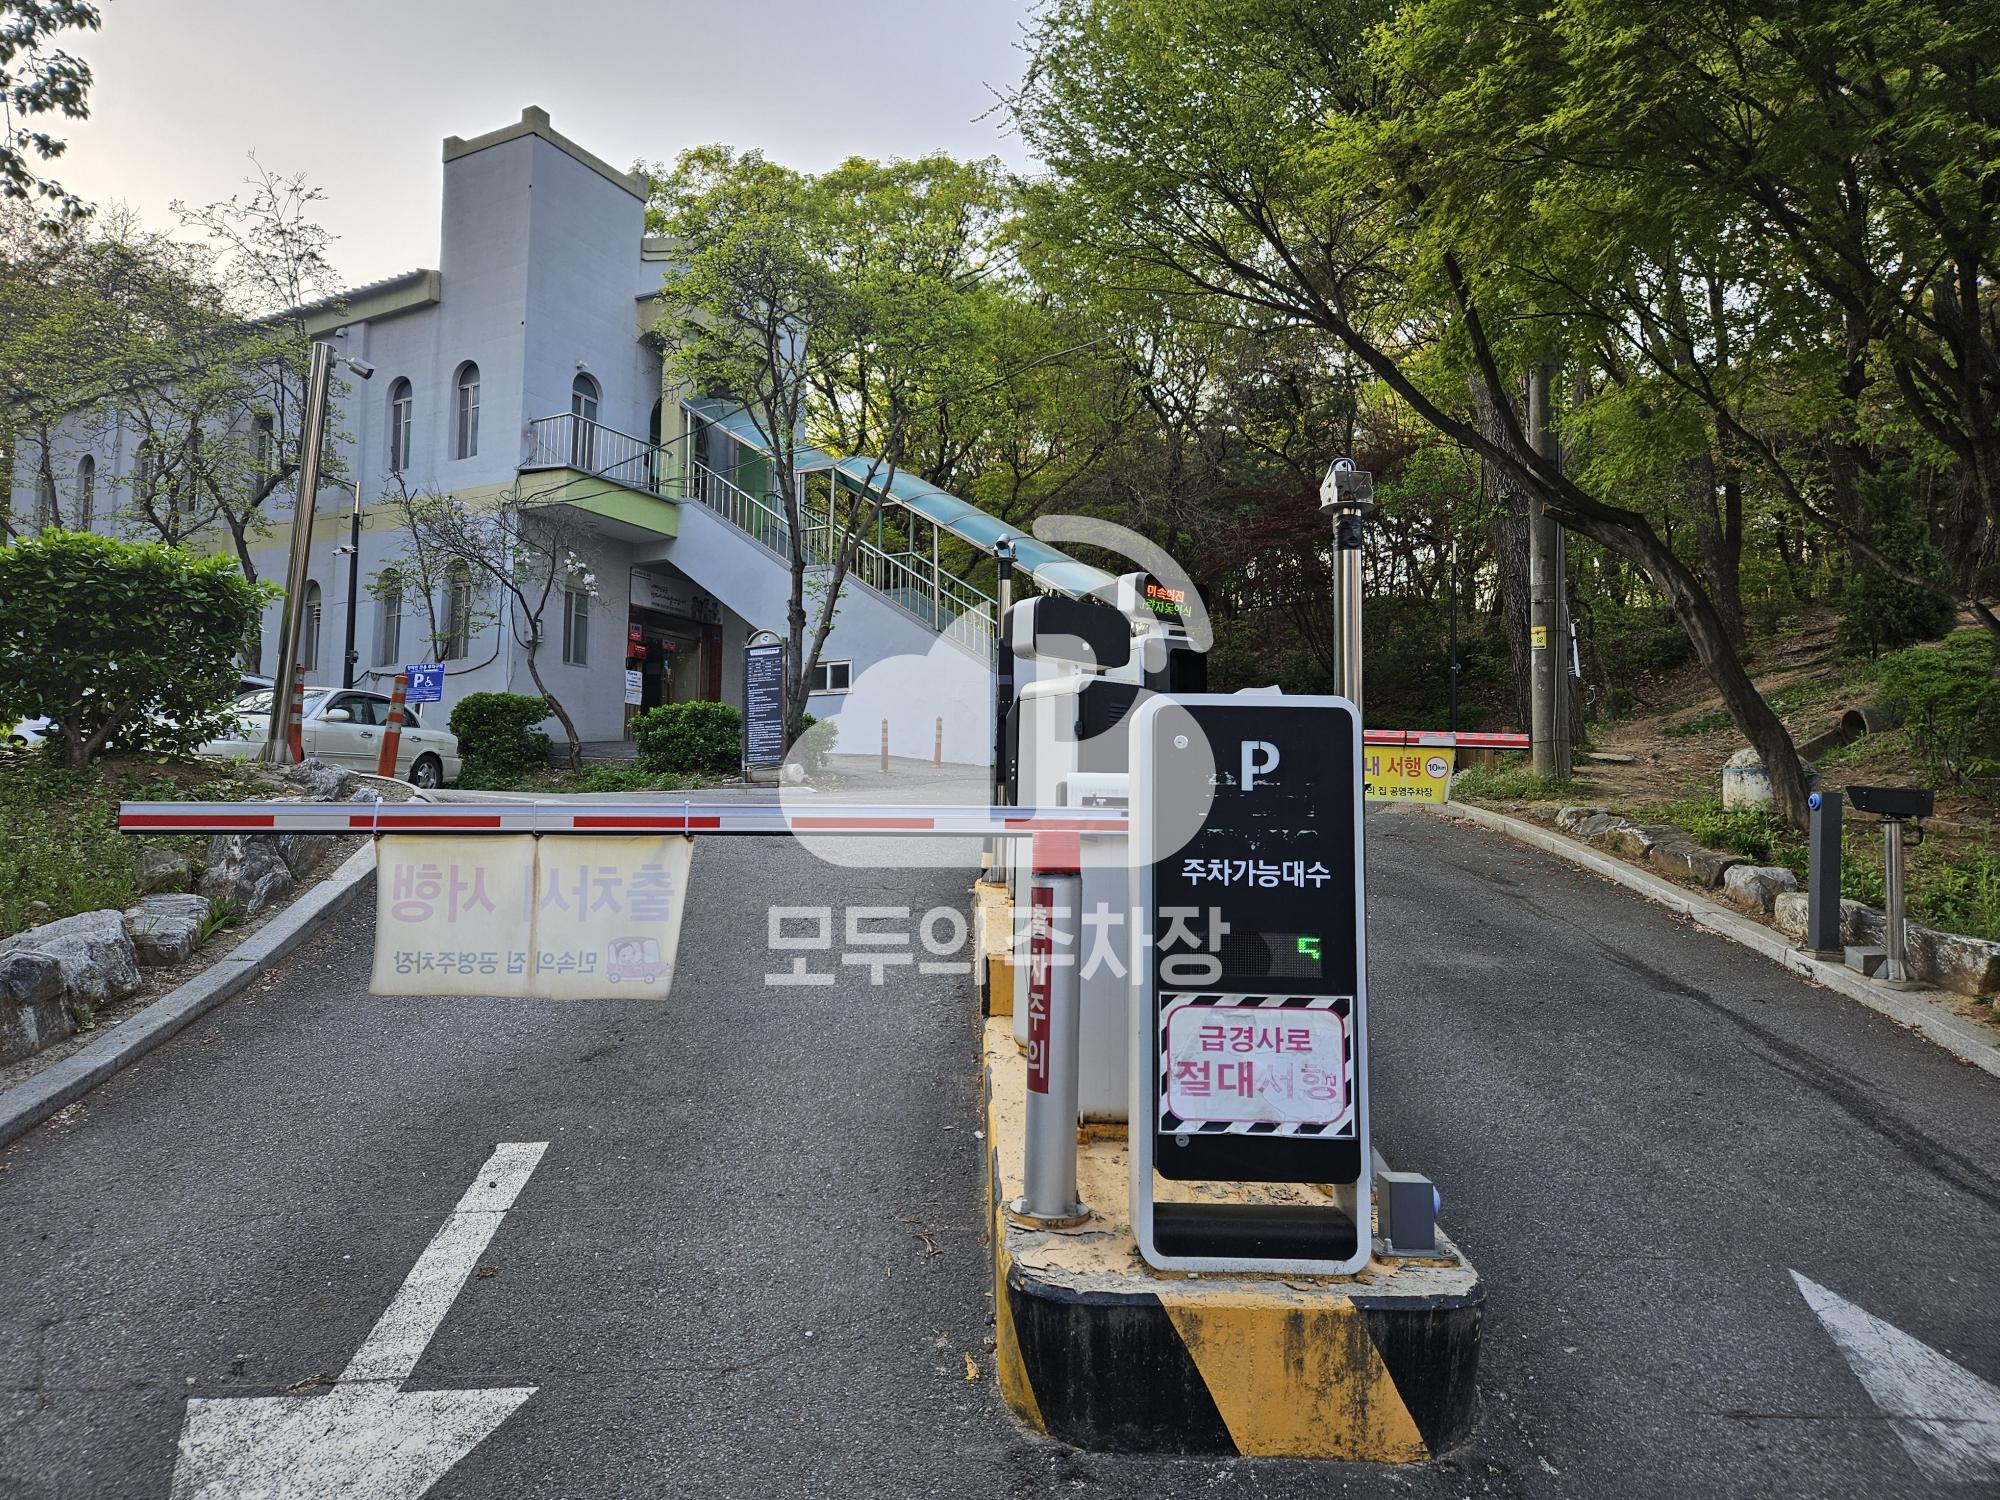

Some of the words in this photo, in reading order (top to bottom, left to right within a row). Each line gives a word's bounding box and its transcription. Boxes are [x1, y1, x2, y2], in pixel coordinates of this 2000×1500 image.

[414, 674, 424, 687] P
[1241, 740, 1280, 791] P
[1387, 756, 1421, 777] 서행
[1378, 787, 1387, 796] 집
[1390, 787, 1433, 797] 공영주차장
[1182, 859, 1331, 888] 주차가능대수
[1199, 1025, 1313, 1054] 급경사로
